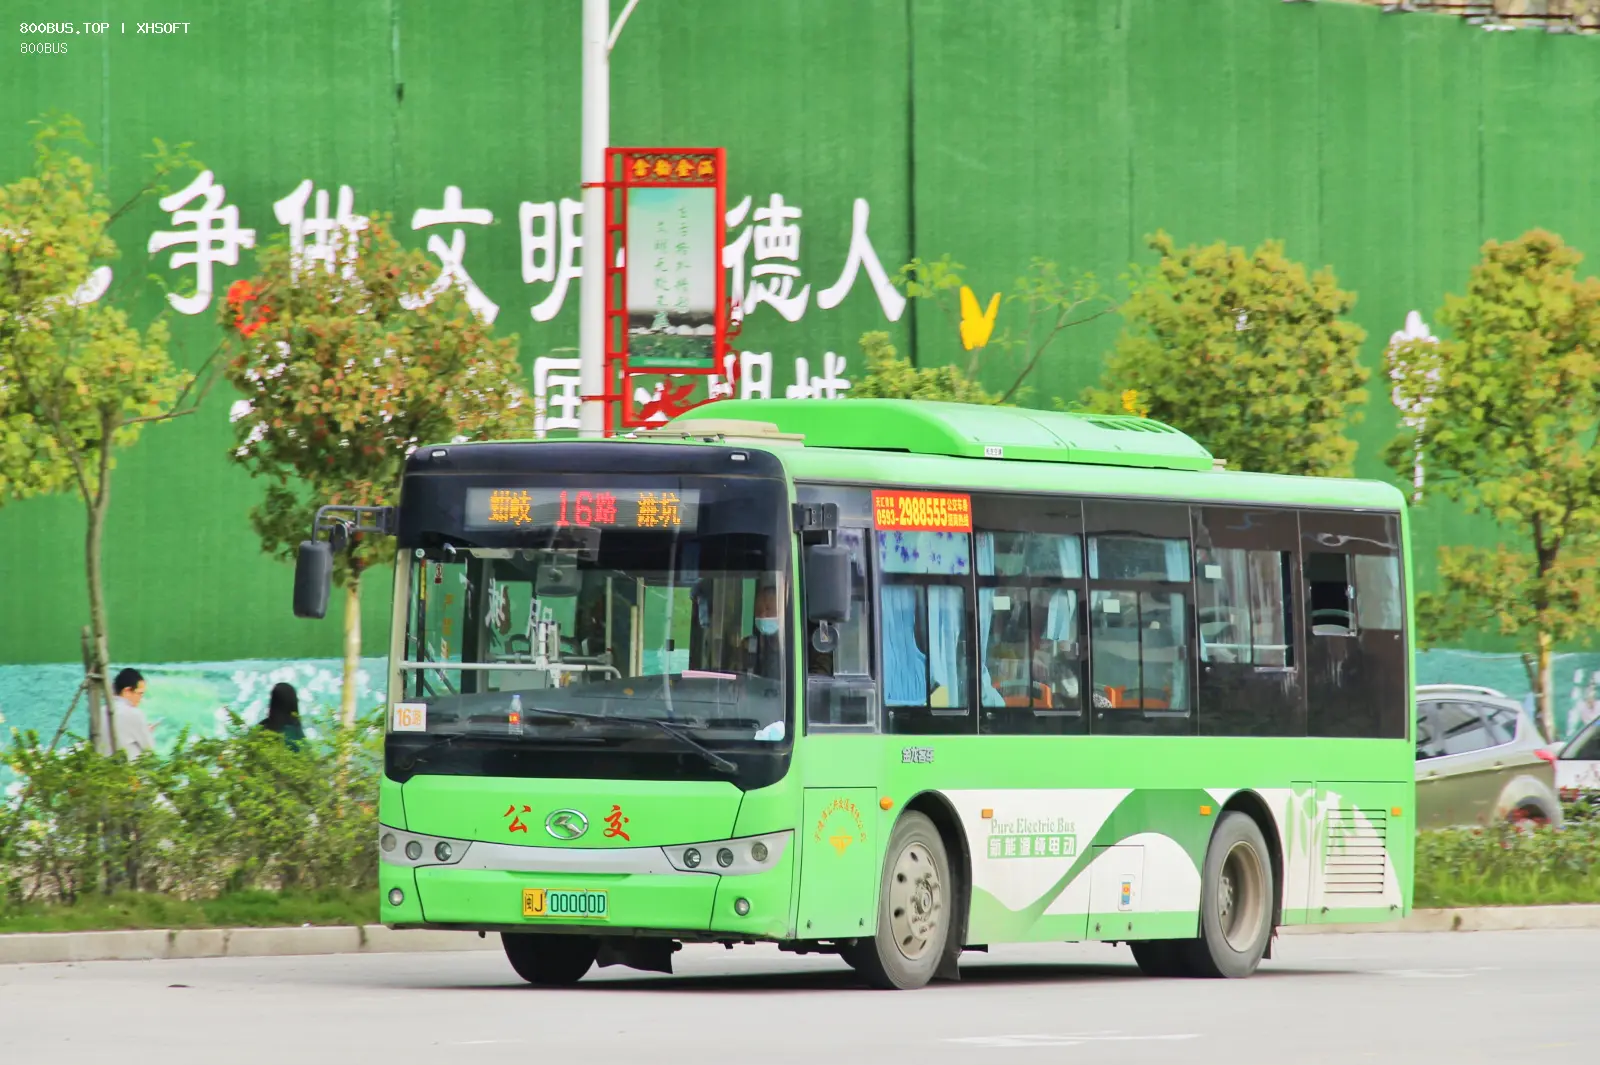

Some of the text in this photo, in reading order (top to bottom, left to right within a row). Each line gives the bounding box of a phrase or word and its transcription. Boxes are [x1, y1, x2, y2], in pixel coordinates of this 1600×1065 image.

[556, 490, 617, 527] 16路
[877, 497, 948, 526] 0593-2988555
[991, 817, 1075, 834] Pure Electric Bus
[989, 836, 1075, 857] 新能源纯电动
